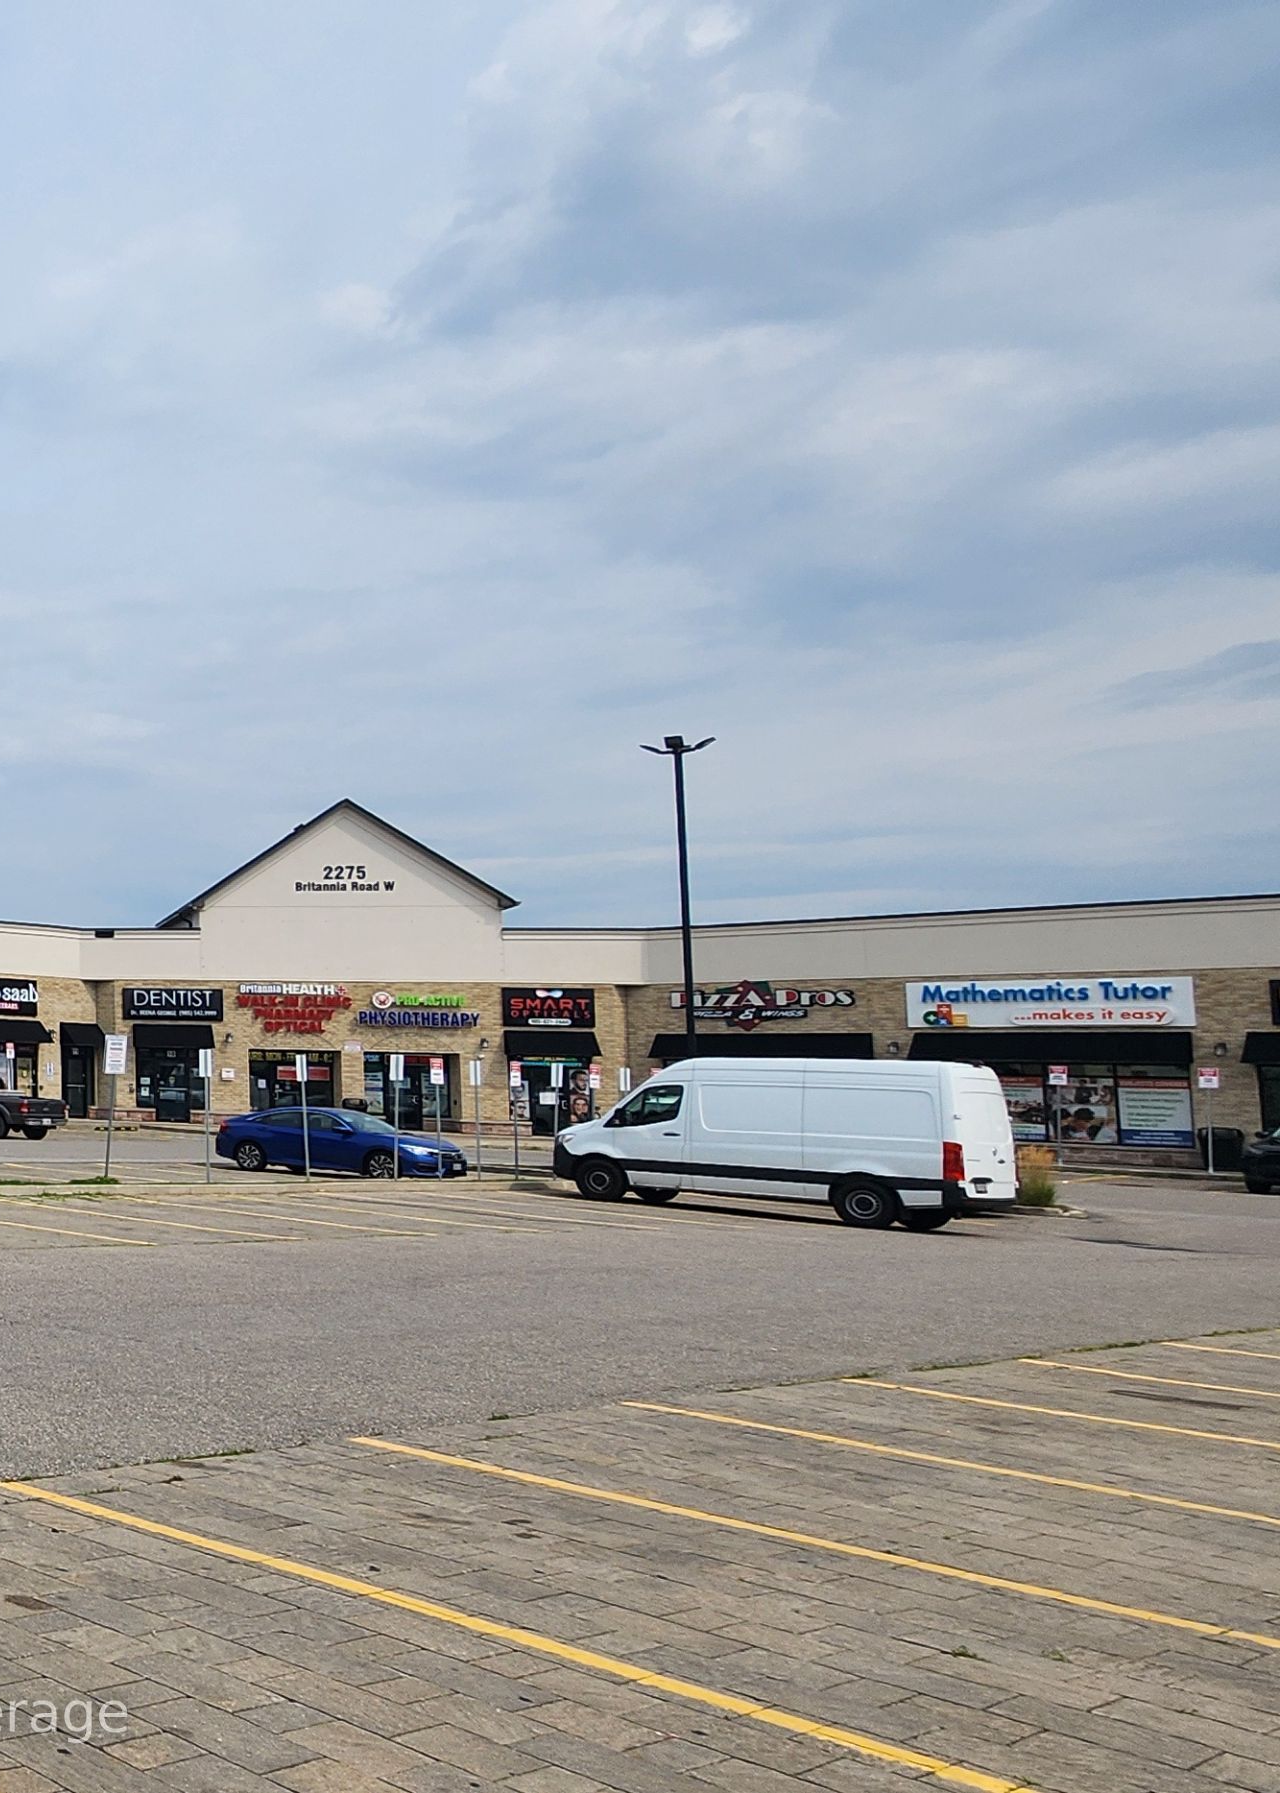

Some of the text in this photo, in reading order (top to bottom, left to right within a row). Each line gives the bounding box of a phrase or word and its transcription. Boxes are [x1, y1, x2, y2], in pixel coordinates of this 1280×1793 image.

[323, 865, 366, 880] 2275
[295, 881, 395, 892] Britannia Road W
[2, 983, 39, 1003] saab
[240, 984, 335, 995] Britannia HEALTH
[921, 980, 1173, 1003] Mathematics Tutor
[133, 989, 213, 1007] DENTIST
[236, 995, 353, 1010] WALK-IN CLINIC
[395, 994, 465, 1007] PRO-ACTIVE
[510, 998, 590, 1010] SMART
[775, 989, 855, 1006] Pros
[254, 1007, 336, 1020] PHARMACY
[358, 1011, 480, 1027] PHYSIOTHERAPY
[510, 1010, 591, 1018] OPTICALS
[738, 1007, 756, 1020] &
[761, 1009, 806, 1017] WINGS
[1102, 1008, 1114, 1020] it
[1121, 1009, 1168, 1023] easy
[263, 1020, 326, 1034] OPTICAL
